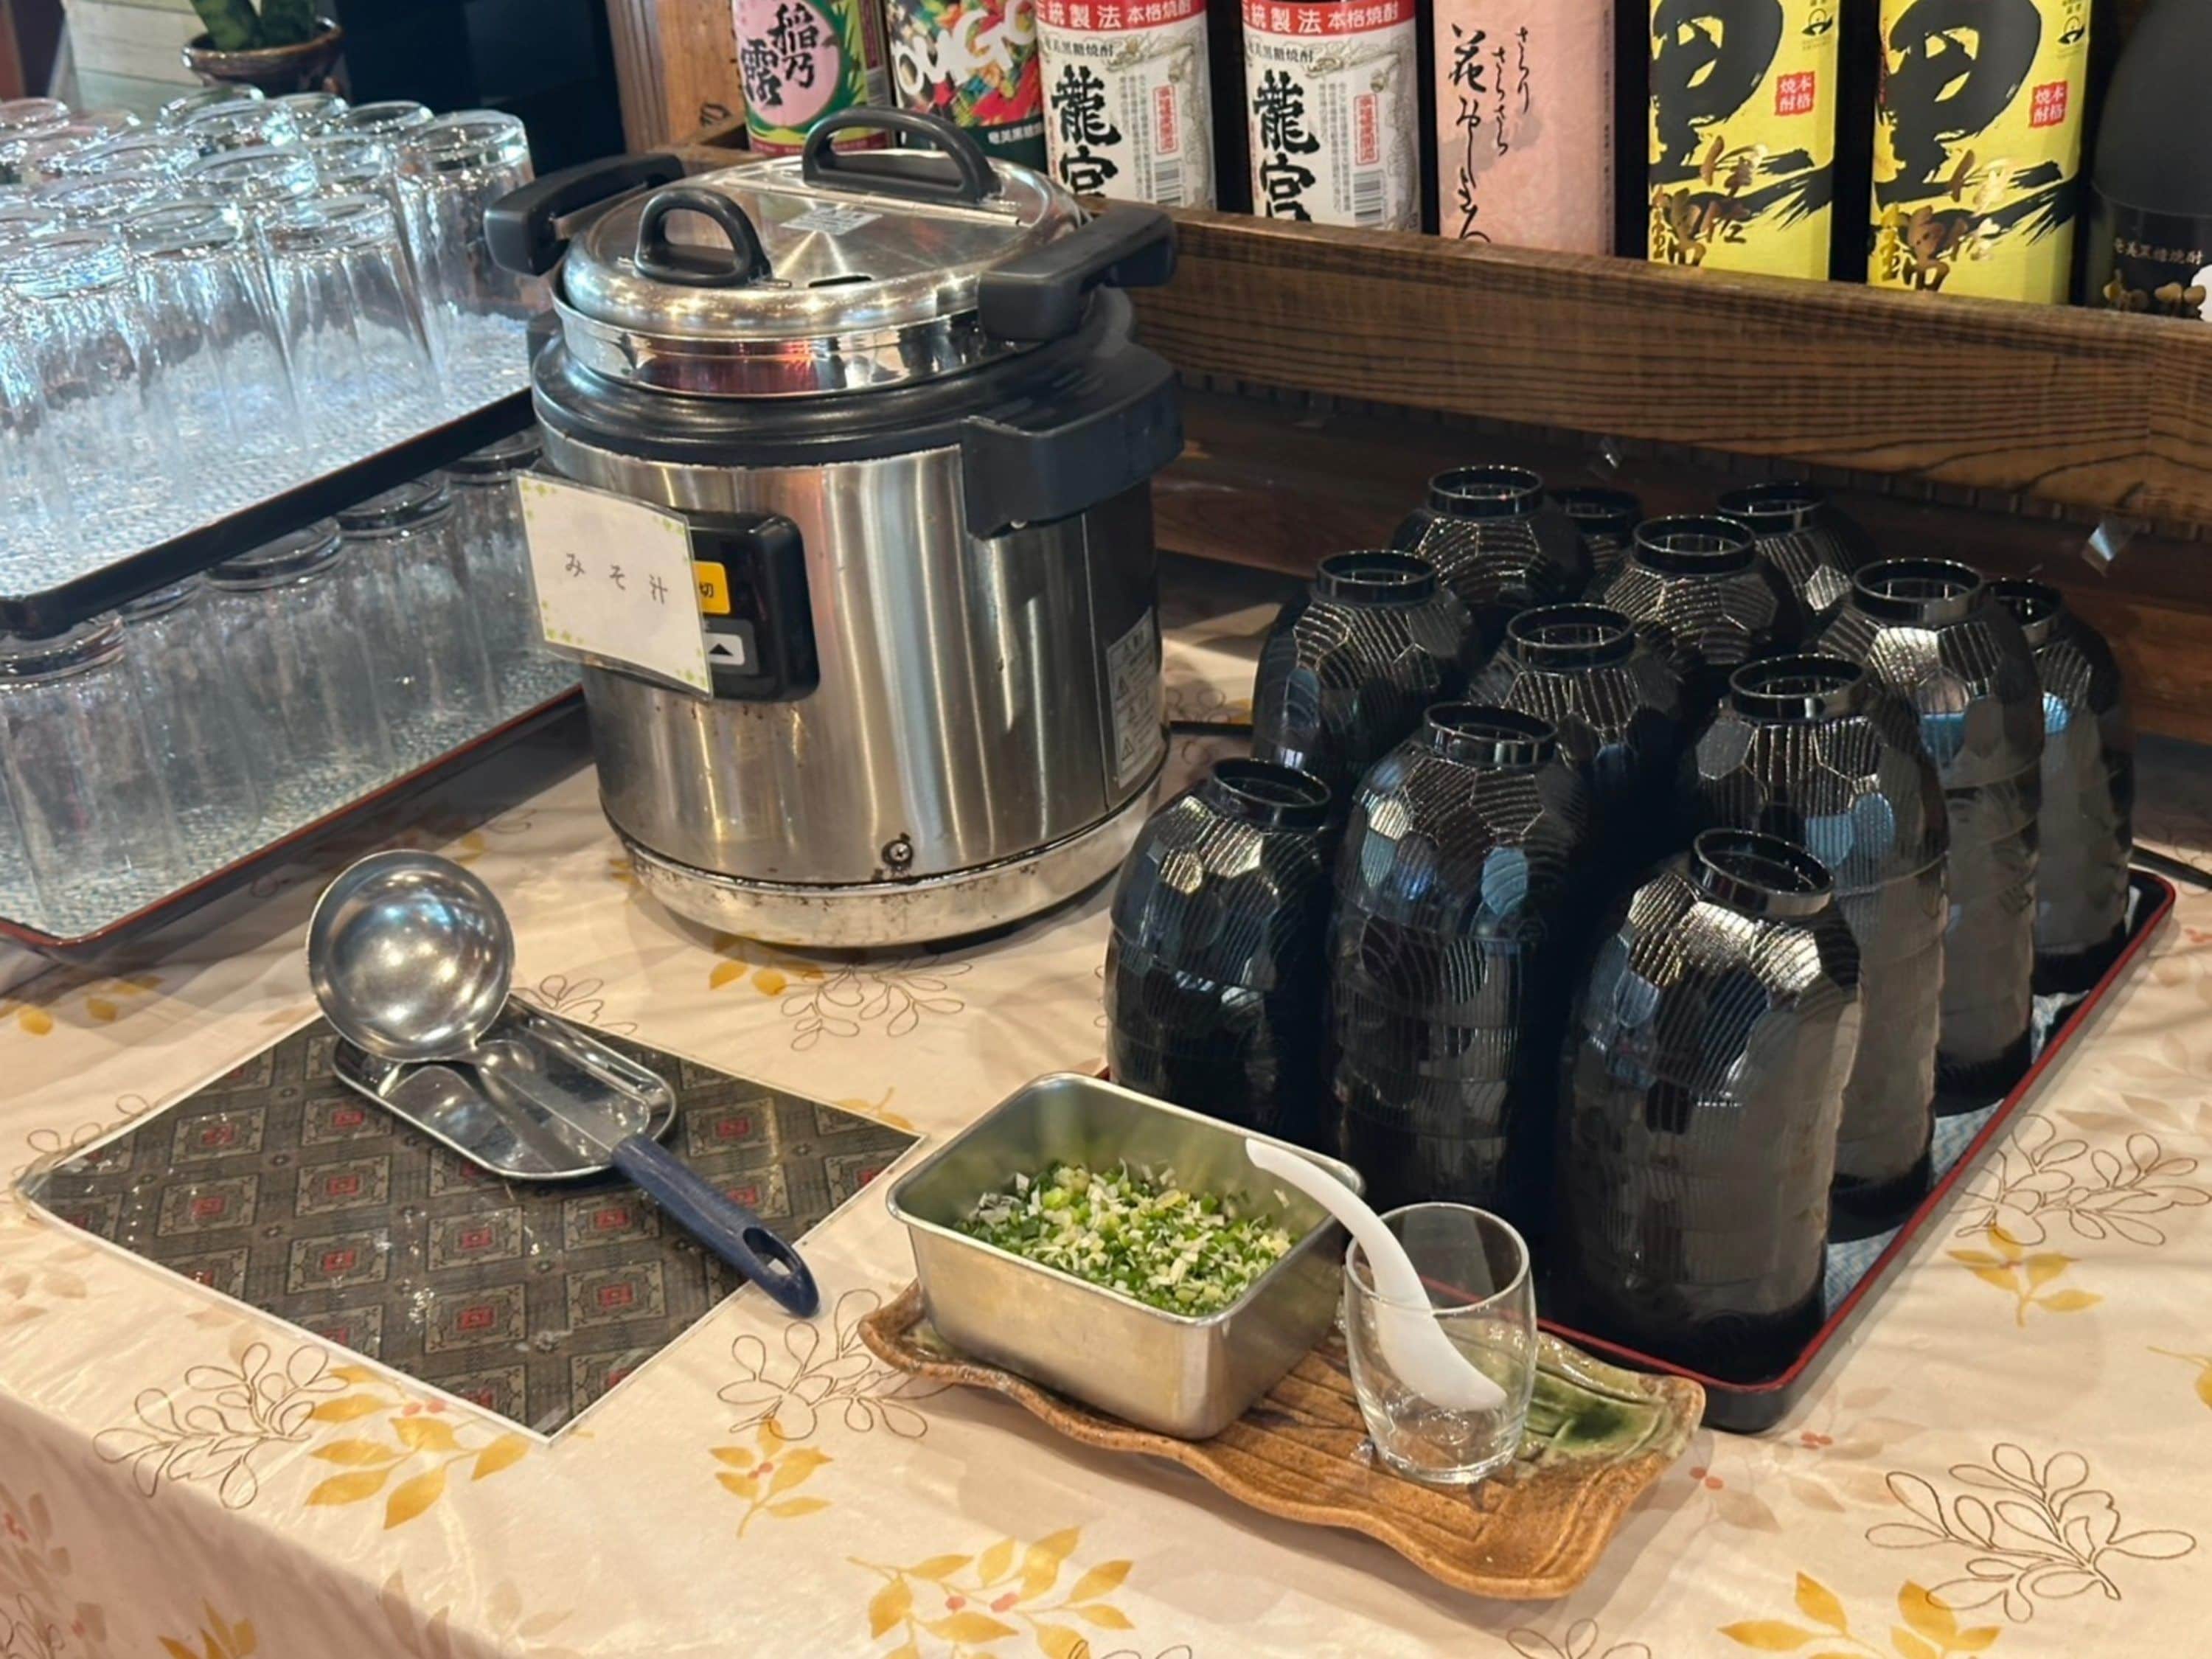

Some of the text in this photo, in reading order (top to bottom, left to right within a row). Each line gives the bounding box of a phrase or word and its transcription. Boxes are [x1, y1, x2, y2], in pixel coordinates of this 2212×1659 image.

[1328, 1, 1399, 30] 本格焼酎
[1051, 63, 1122, 198] 龍宮
[1252, 69, 1321, 223] 龍宮
[565, 553, 668, 605] みそ汁
